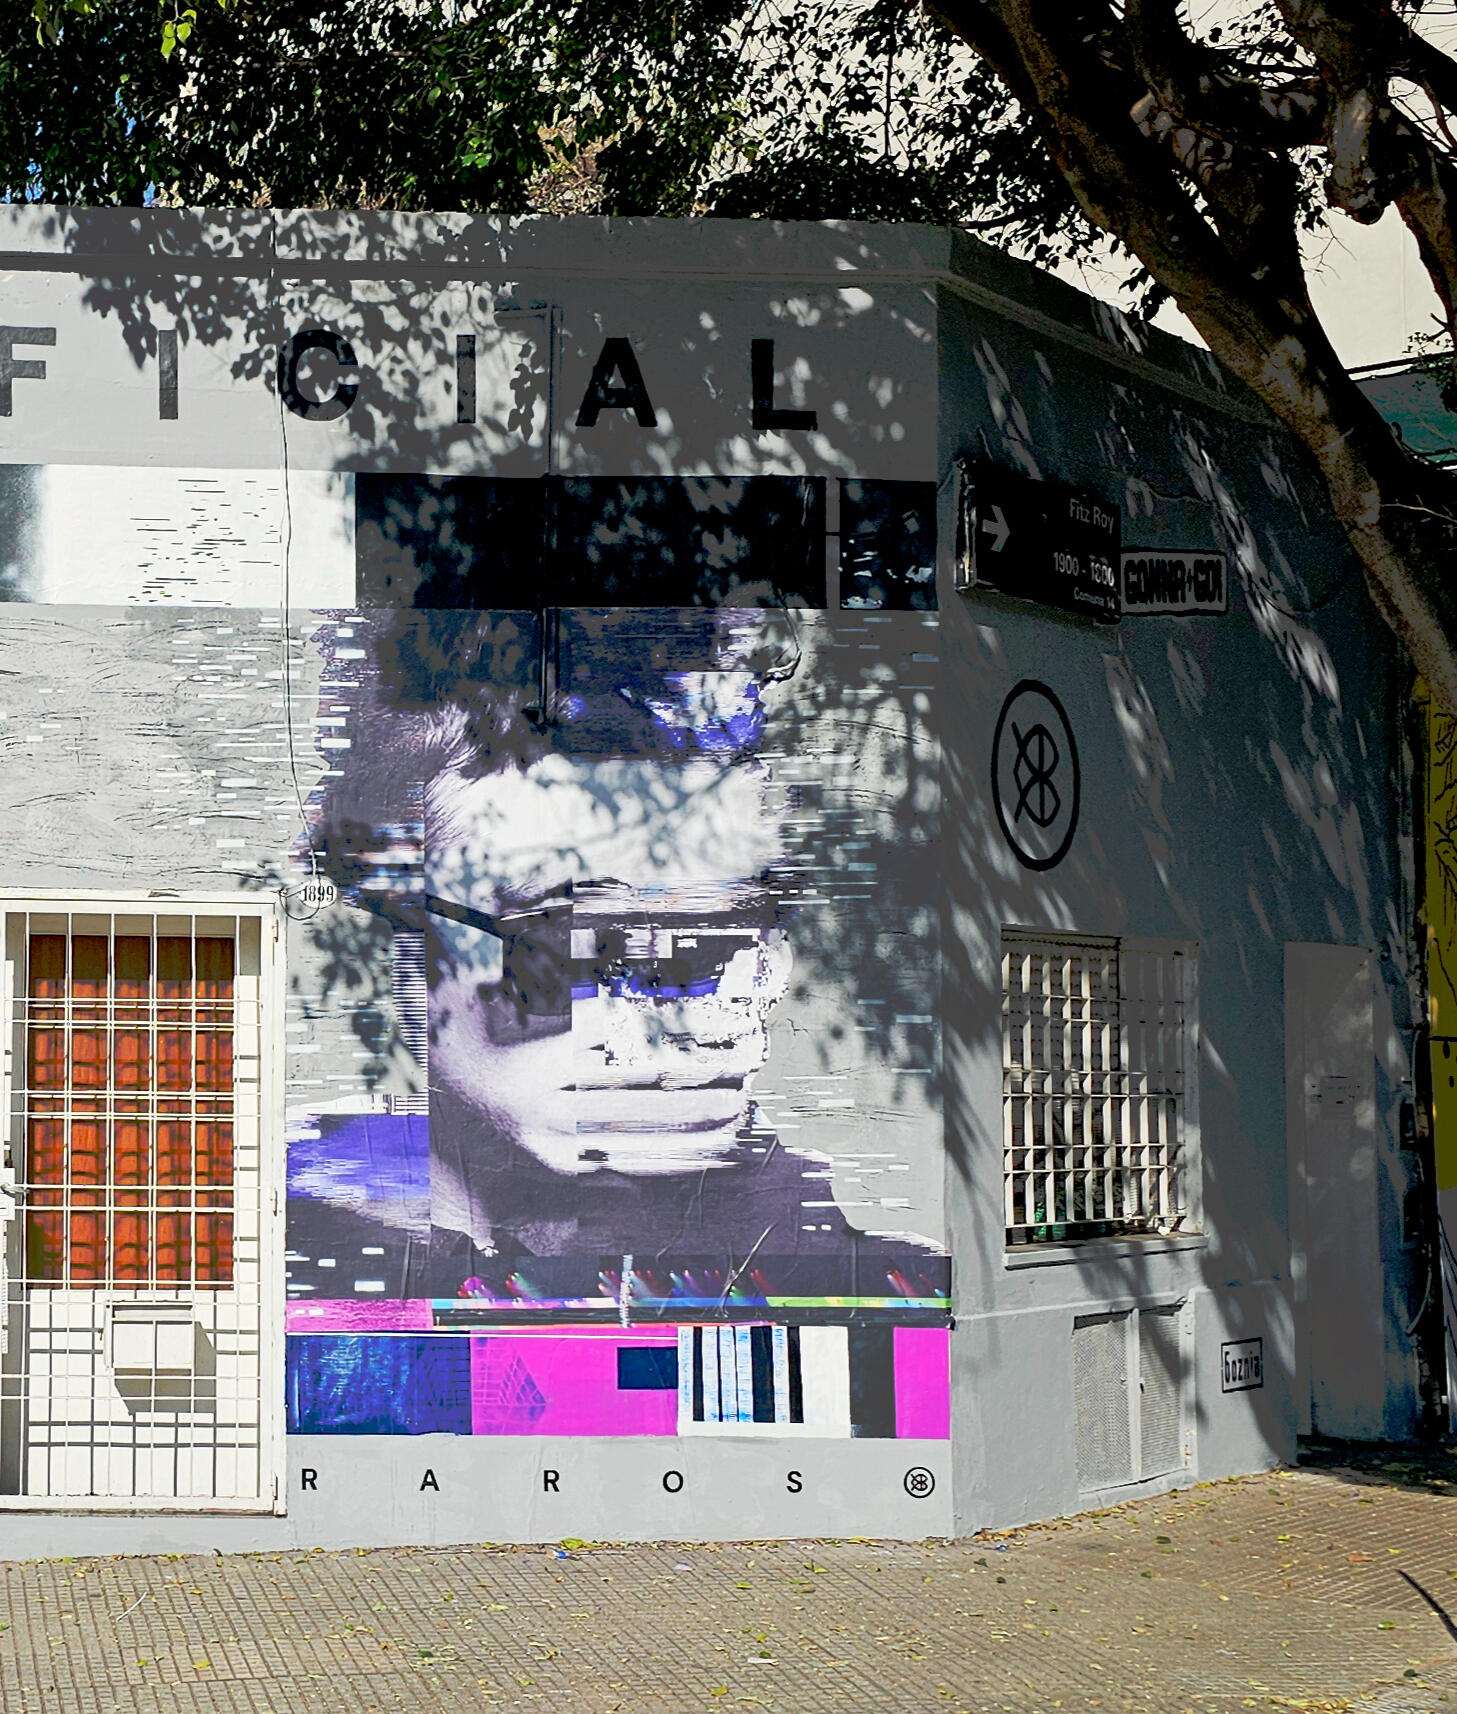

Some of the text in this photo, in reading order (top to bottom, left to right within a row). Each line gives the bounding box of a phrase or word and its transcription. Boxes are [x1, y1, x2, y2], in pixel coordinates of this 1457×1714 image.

[1069, 498, 1114, 534] Fitz Roy
[1053, 551, 1079, 577] 1900
[302, 885, 334, 902] 1899
[300, 1467, 804, 1495] RAROS
